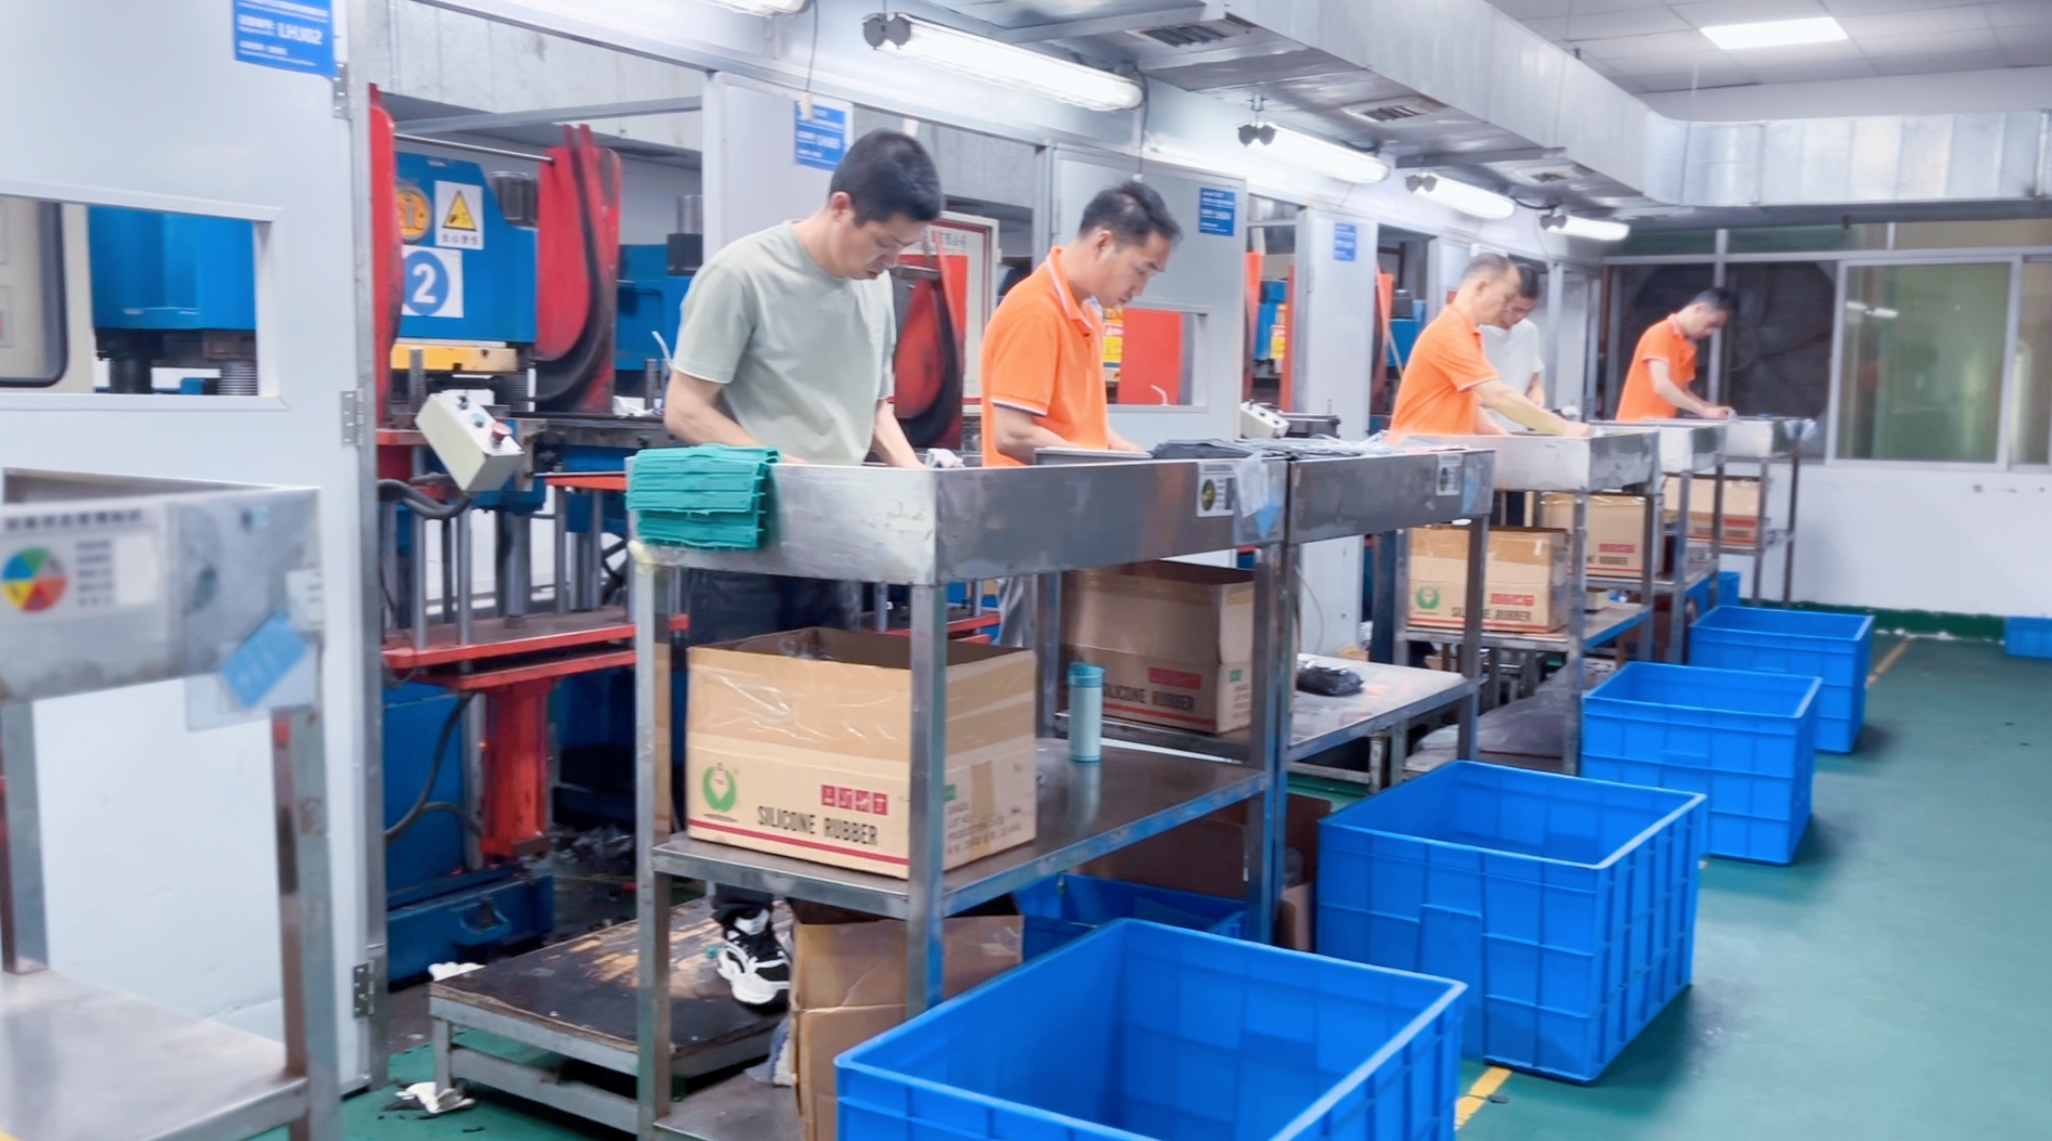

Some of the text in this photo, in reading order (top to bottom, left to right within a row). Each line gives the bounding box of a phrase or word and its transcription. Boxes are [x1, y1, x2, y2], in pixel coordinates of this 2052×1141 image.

[412, 262, 438, 304] 2
[1496, 609, 1532, 622] RUBBER
[1151, 689, 1195, 712] RUBBER
[757, 805, 879, 847] SILICONE RUBBER
